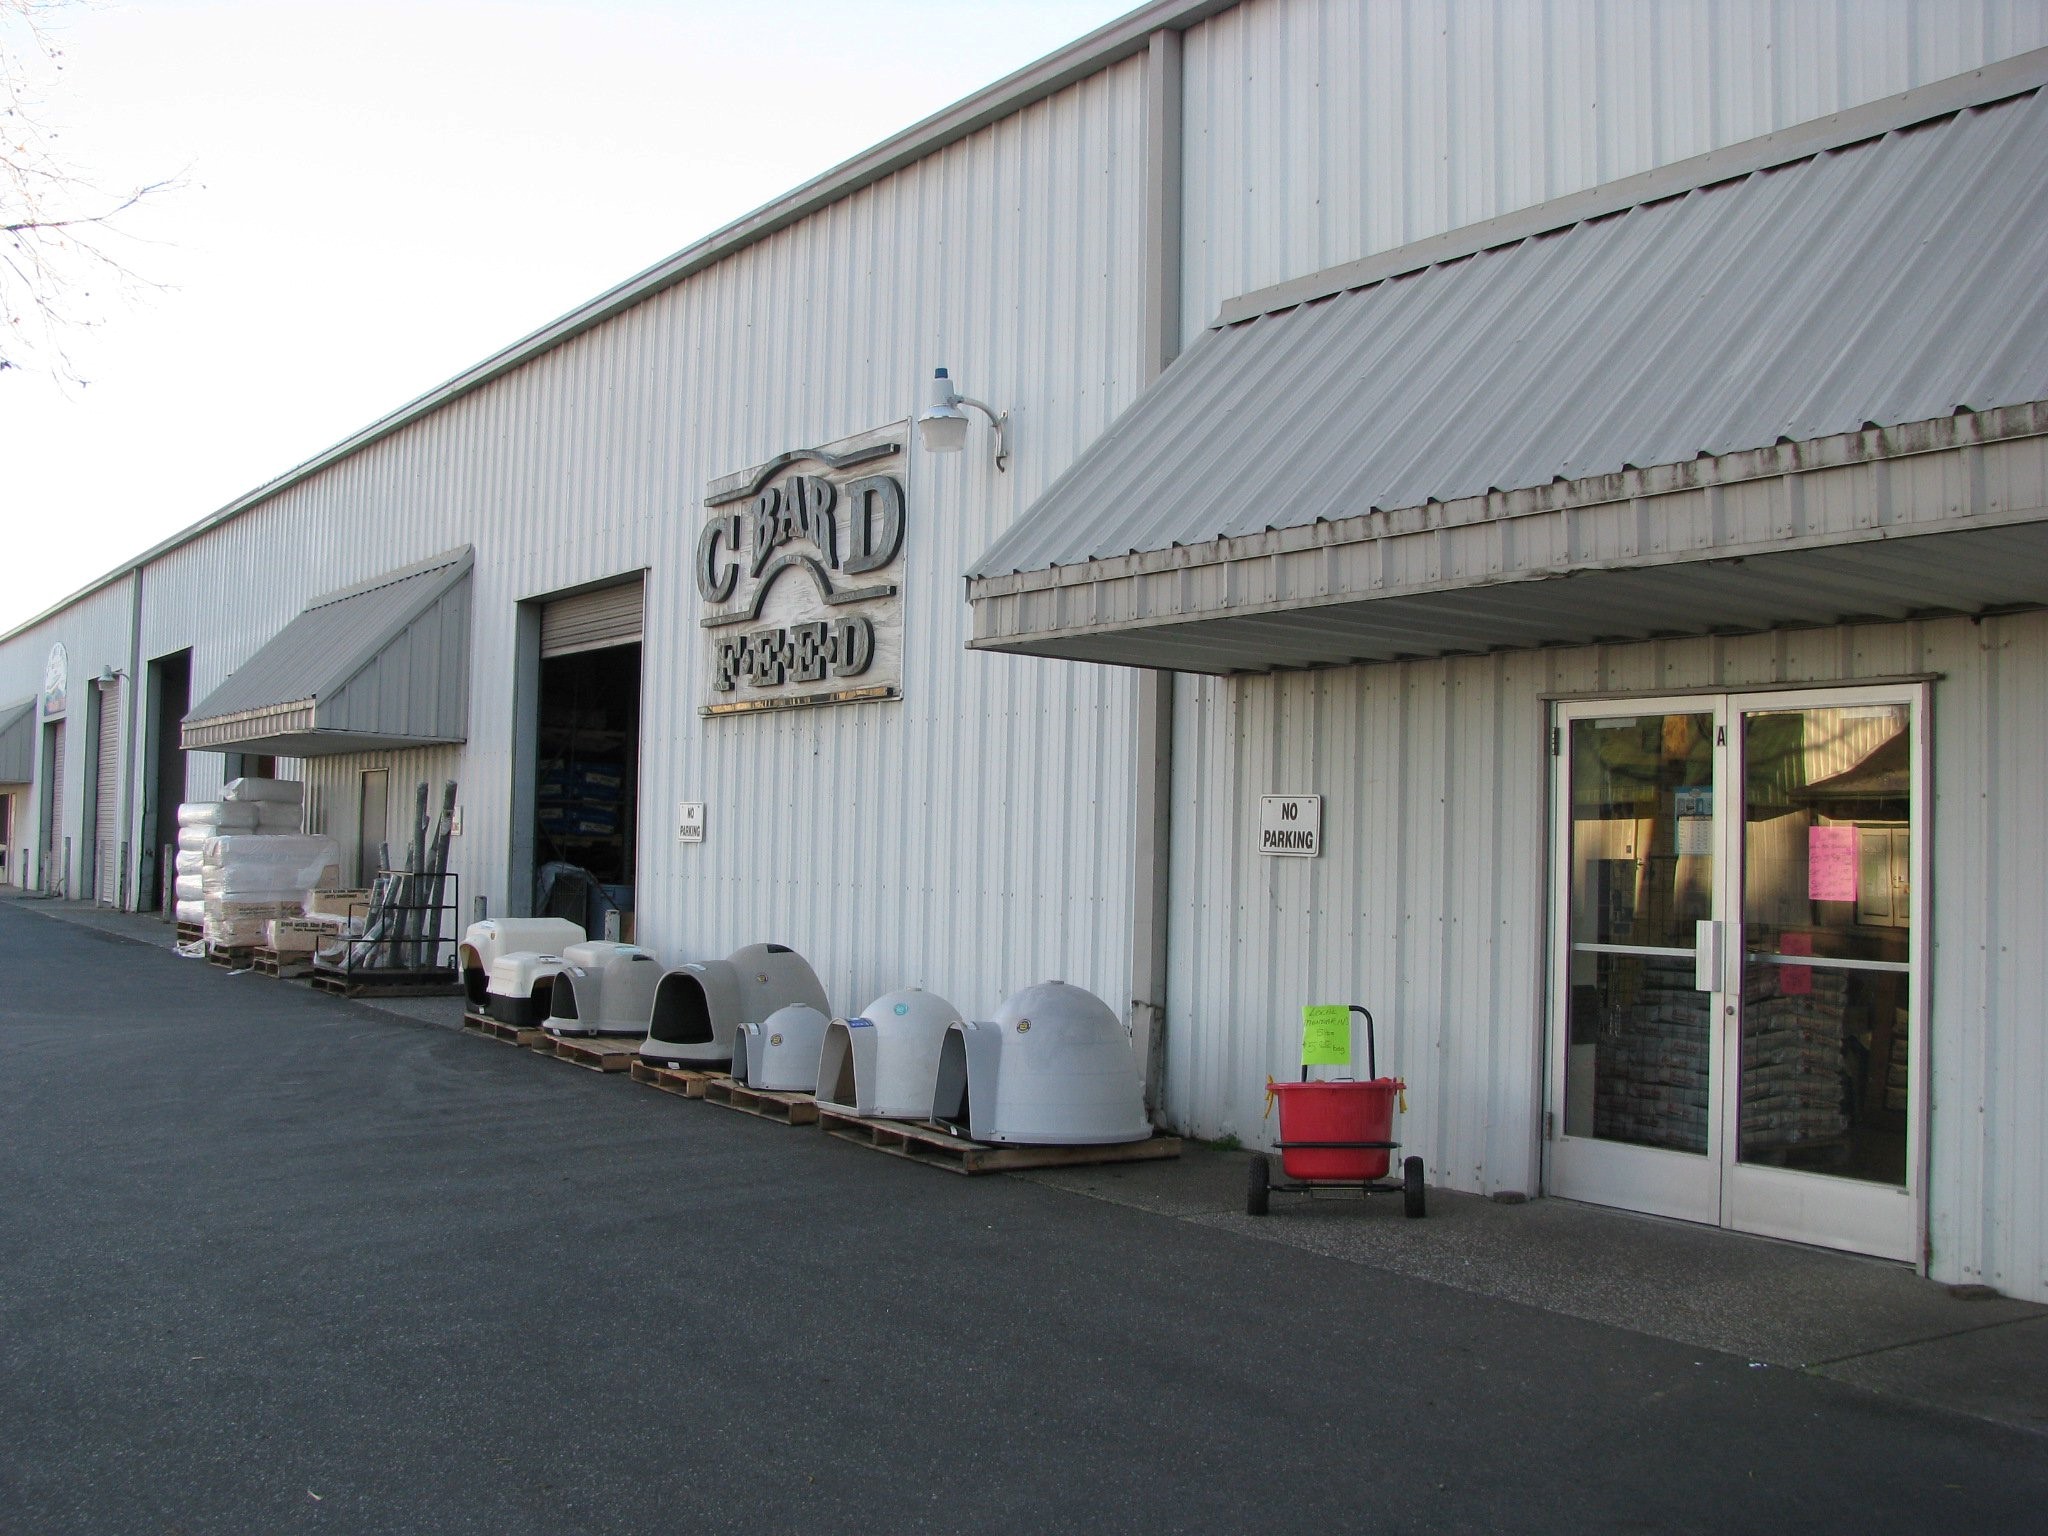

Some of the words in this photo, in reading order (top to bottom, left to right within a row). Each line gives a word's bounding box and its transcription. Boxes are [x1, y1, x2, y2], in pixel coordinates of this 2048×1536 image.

[696, 515, 742, 604] C
[750, 475, 840, 579] BAR
[842, 474, 907, 576] D
[713, 616, 876, 692] FEED
[1716, 726, 1726, 747] A
[687, 807, 696, 819] NO
[1281, 802, 1298, 821] NO
[679, 825, 701, 837] PARKING
[1262, 829, 1314, 849] PARKING
